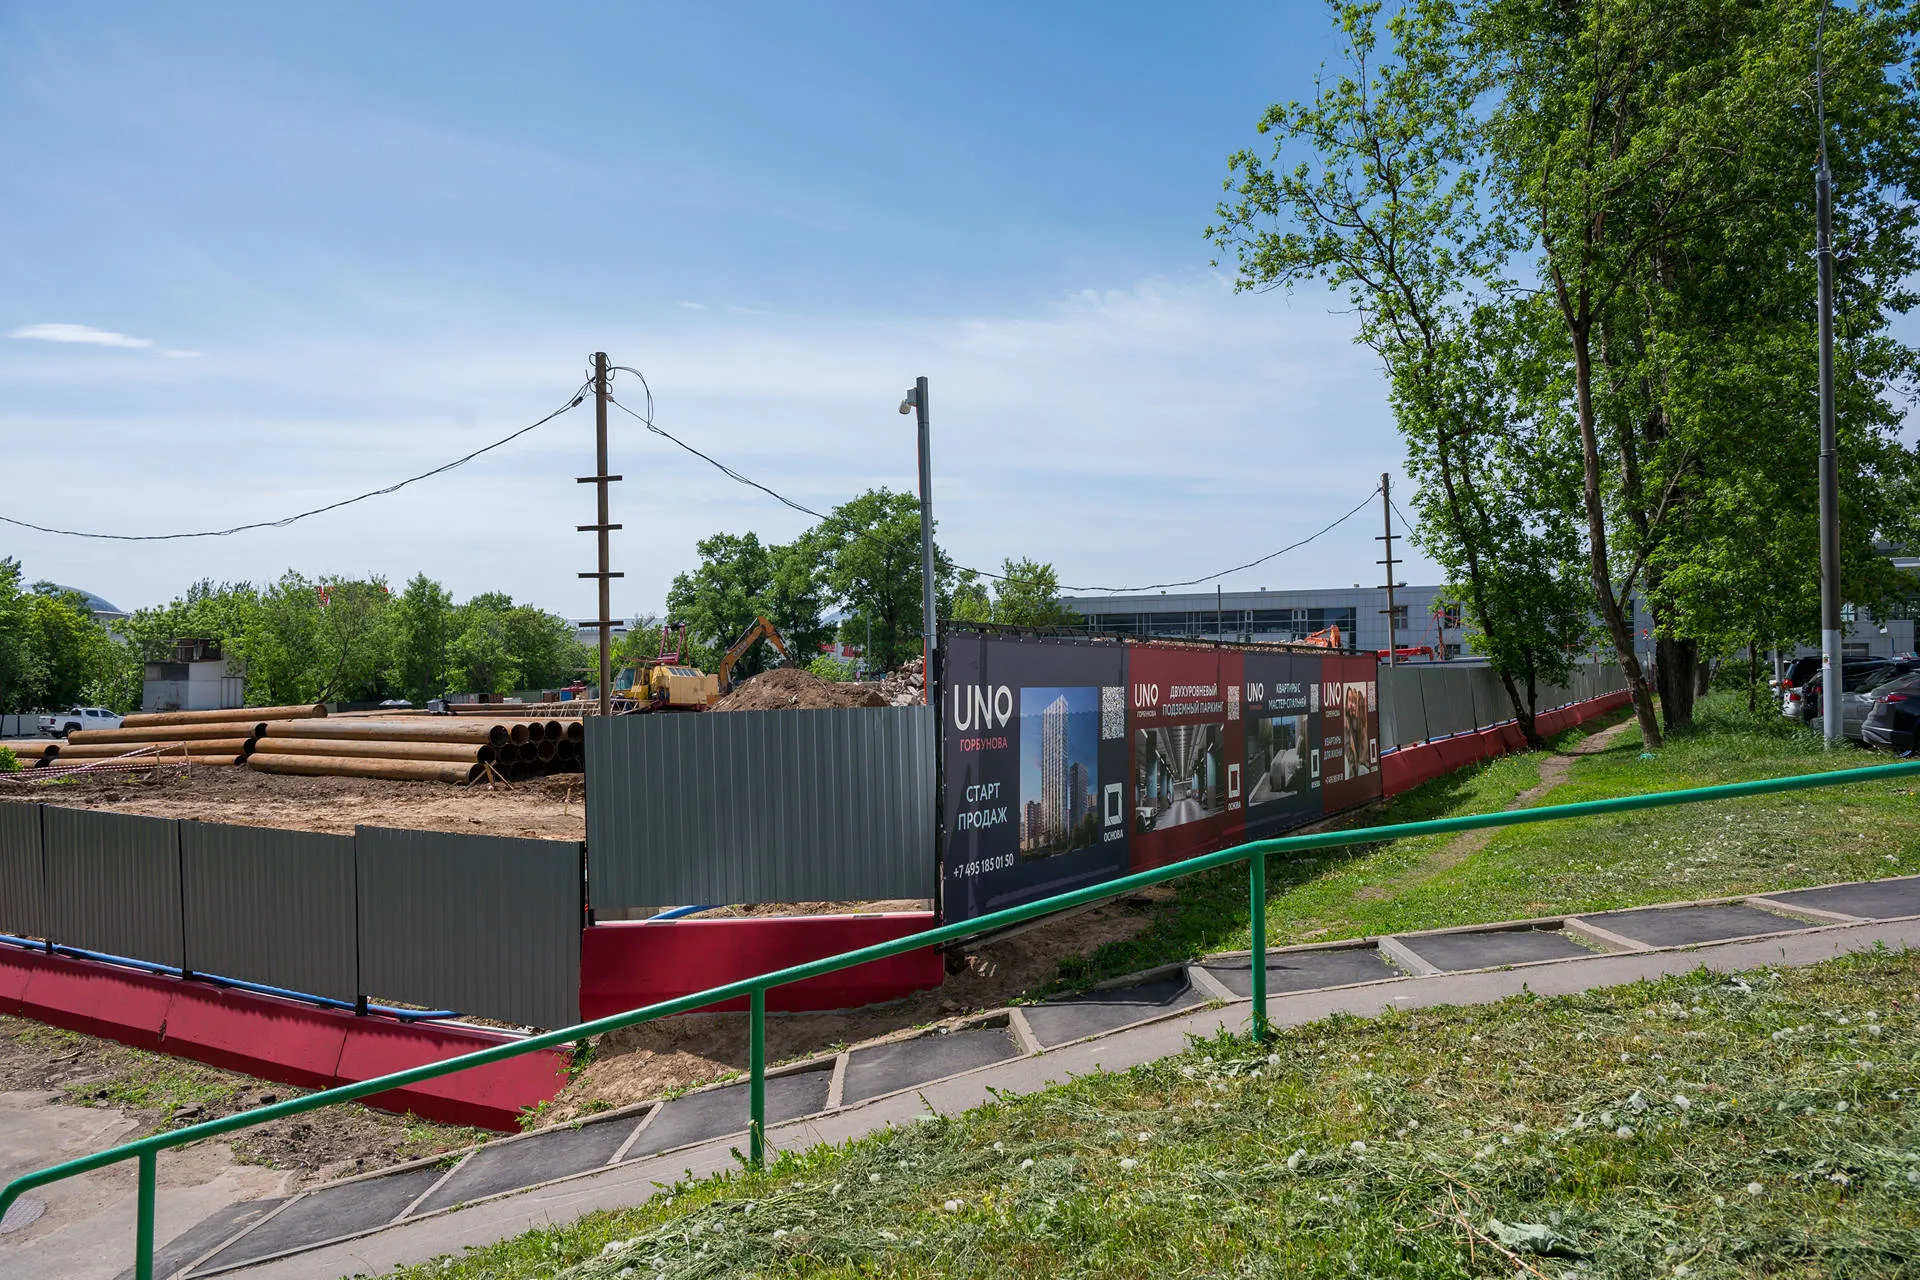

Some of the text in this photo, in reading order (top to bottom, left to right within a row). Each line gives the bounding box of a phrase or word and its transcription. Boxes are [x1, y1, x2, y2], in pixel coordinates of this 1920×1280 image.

[1134, 683, 1159, 708] UNO
[1170, 683, 1218, 699] ДВУХУРОВНЕВЫЙ
[1247, 682, 1264, 702] UNO
[1323, 682, 1342, 707] UNO
[954, 685, 1013, 731] UNO
[1162, 700, 1224, 717] ПОДЗЕМНЫЙ ПАРКИНГ
[960, 736, 1009, 752] ГОРБУНОВА
[966, 782, 1001, 803] СТАРТ
[958, 806, 1008, 831] ПРОДАЖ
[1103, 829, 1124, 843] ОСНОВА
[953, 852, 1014, 879] +7 495 185 01 50
